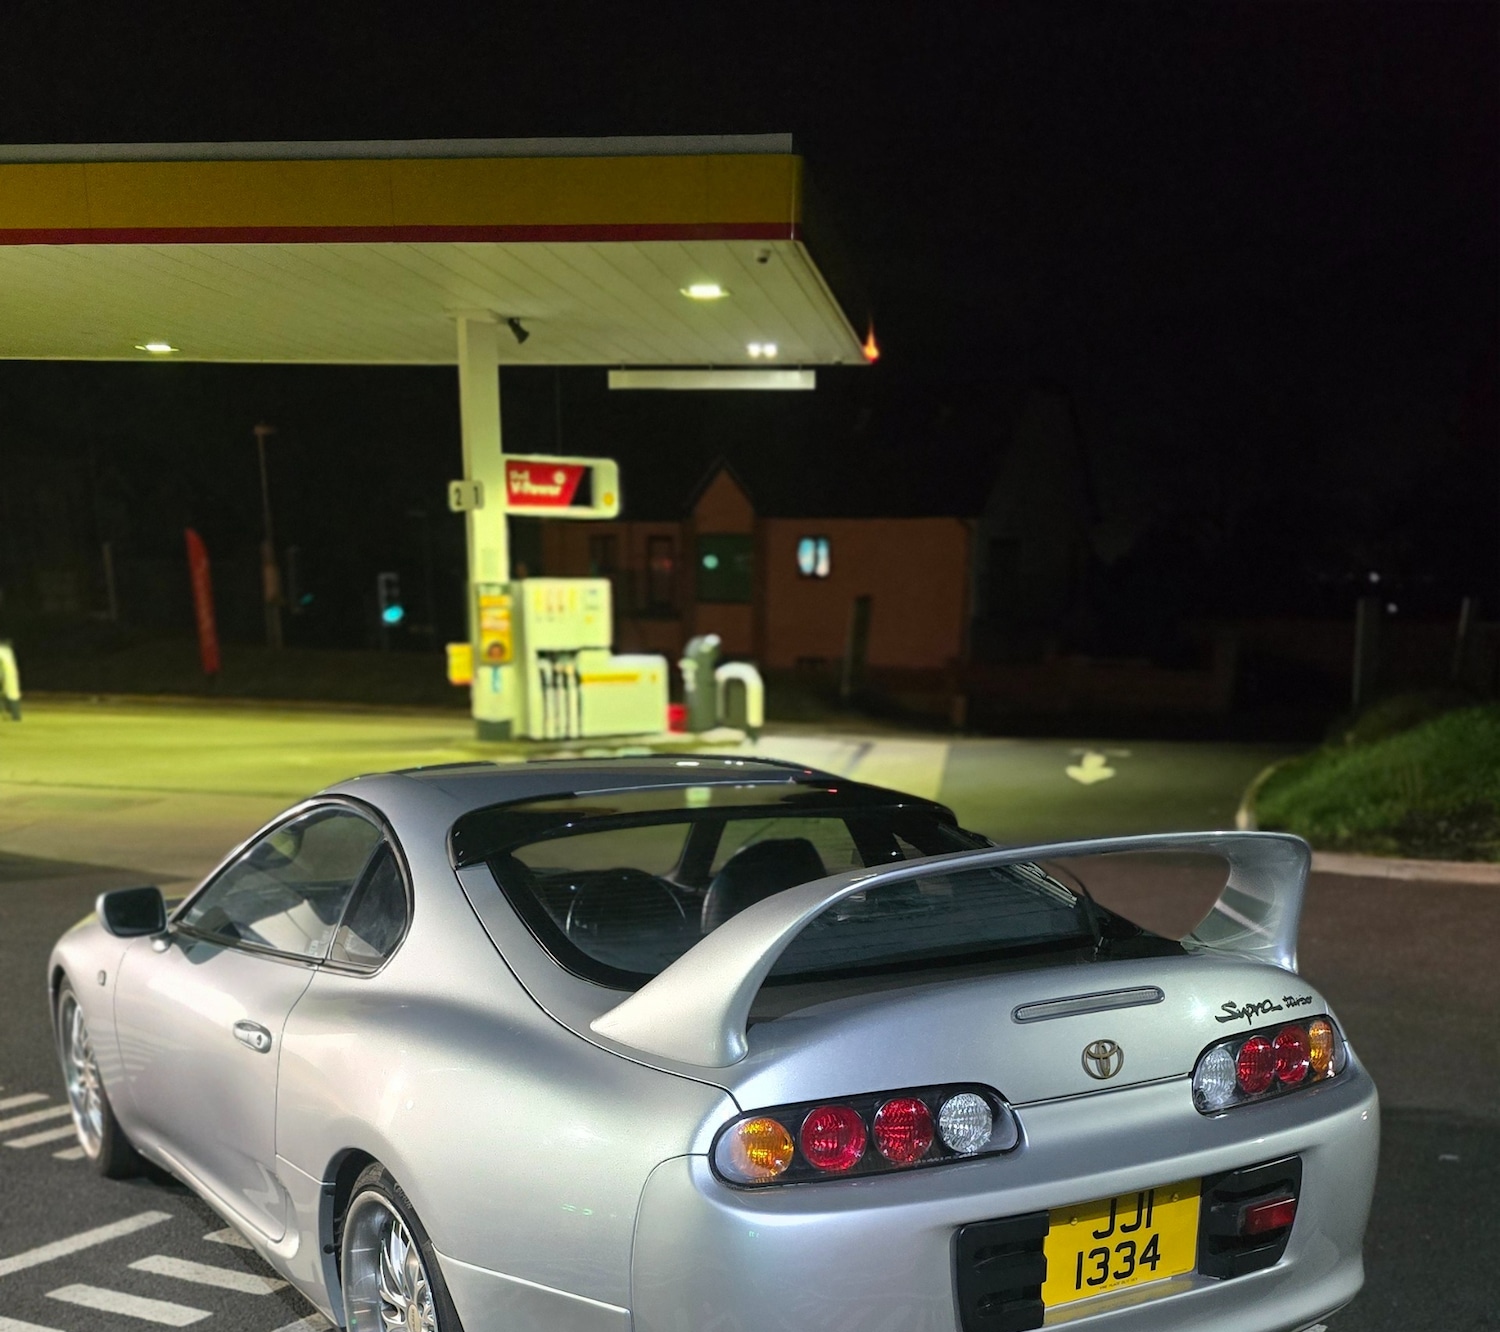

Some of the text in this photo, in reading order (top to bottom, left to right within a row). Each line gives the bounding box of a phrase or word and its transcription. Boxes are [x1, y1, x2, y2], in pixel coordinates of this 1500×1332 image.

[454, 488, 462, 506] 2
[1214, 999, 1283, 1026] Supra
[1075, 1233, 1161, 1290] 1334
